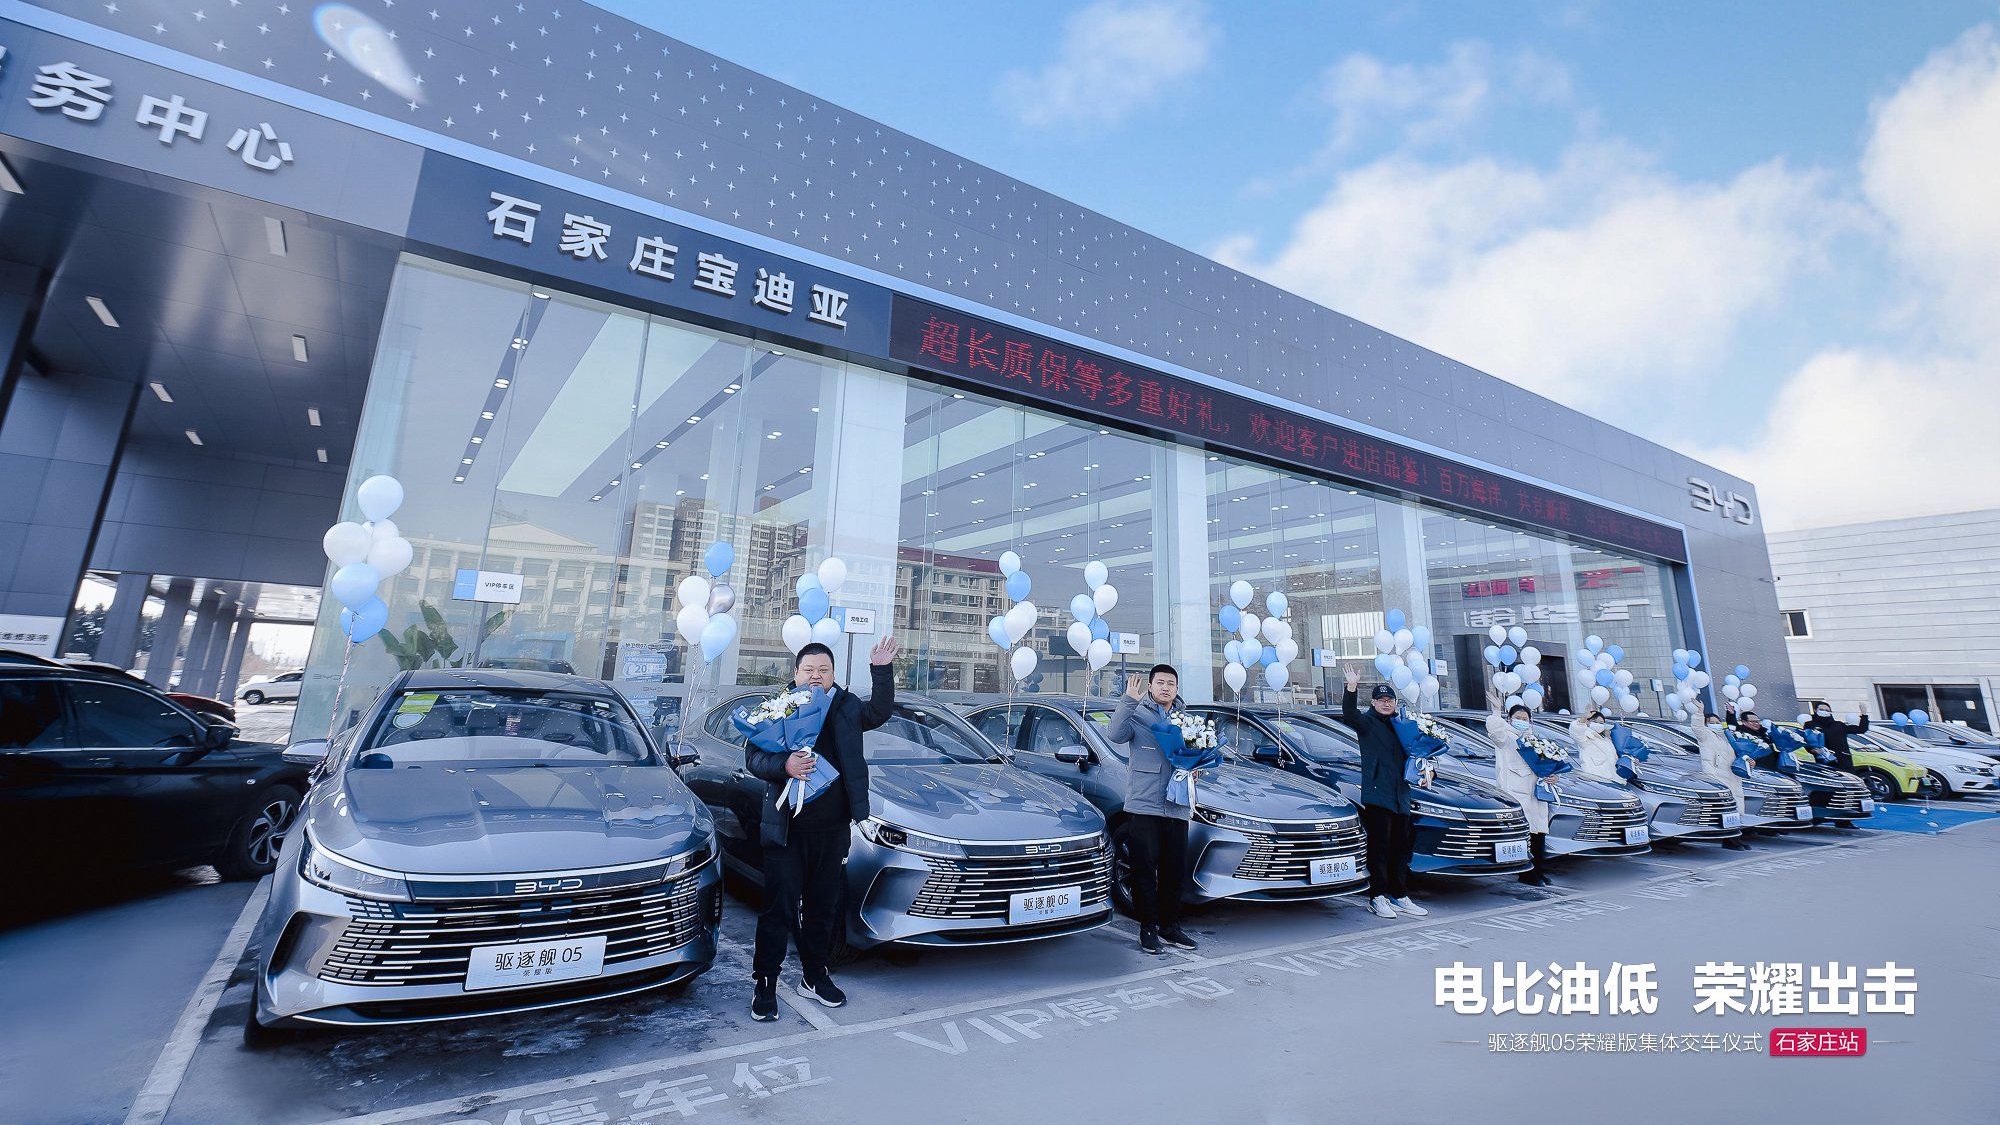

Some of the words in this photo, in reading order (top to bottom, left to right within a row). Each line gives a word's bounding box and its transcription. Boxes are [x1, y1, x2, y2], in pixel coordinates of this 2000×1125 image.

[0, 44, 294, 171] 务中心
[487, 191, 849, 328] 石家庄宝迪亚
[1688, 477, 1754, 525] BYD
[634, 664, 648, 674] 20
[1314, 822, 1339, 831] BYD
[1025, 844, 1062, 855] BYD
[514, 878, 583, 894] BYD
[893, 973, 1236, 1057] VIP停车位
